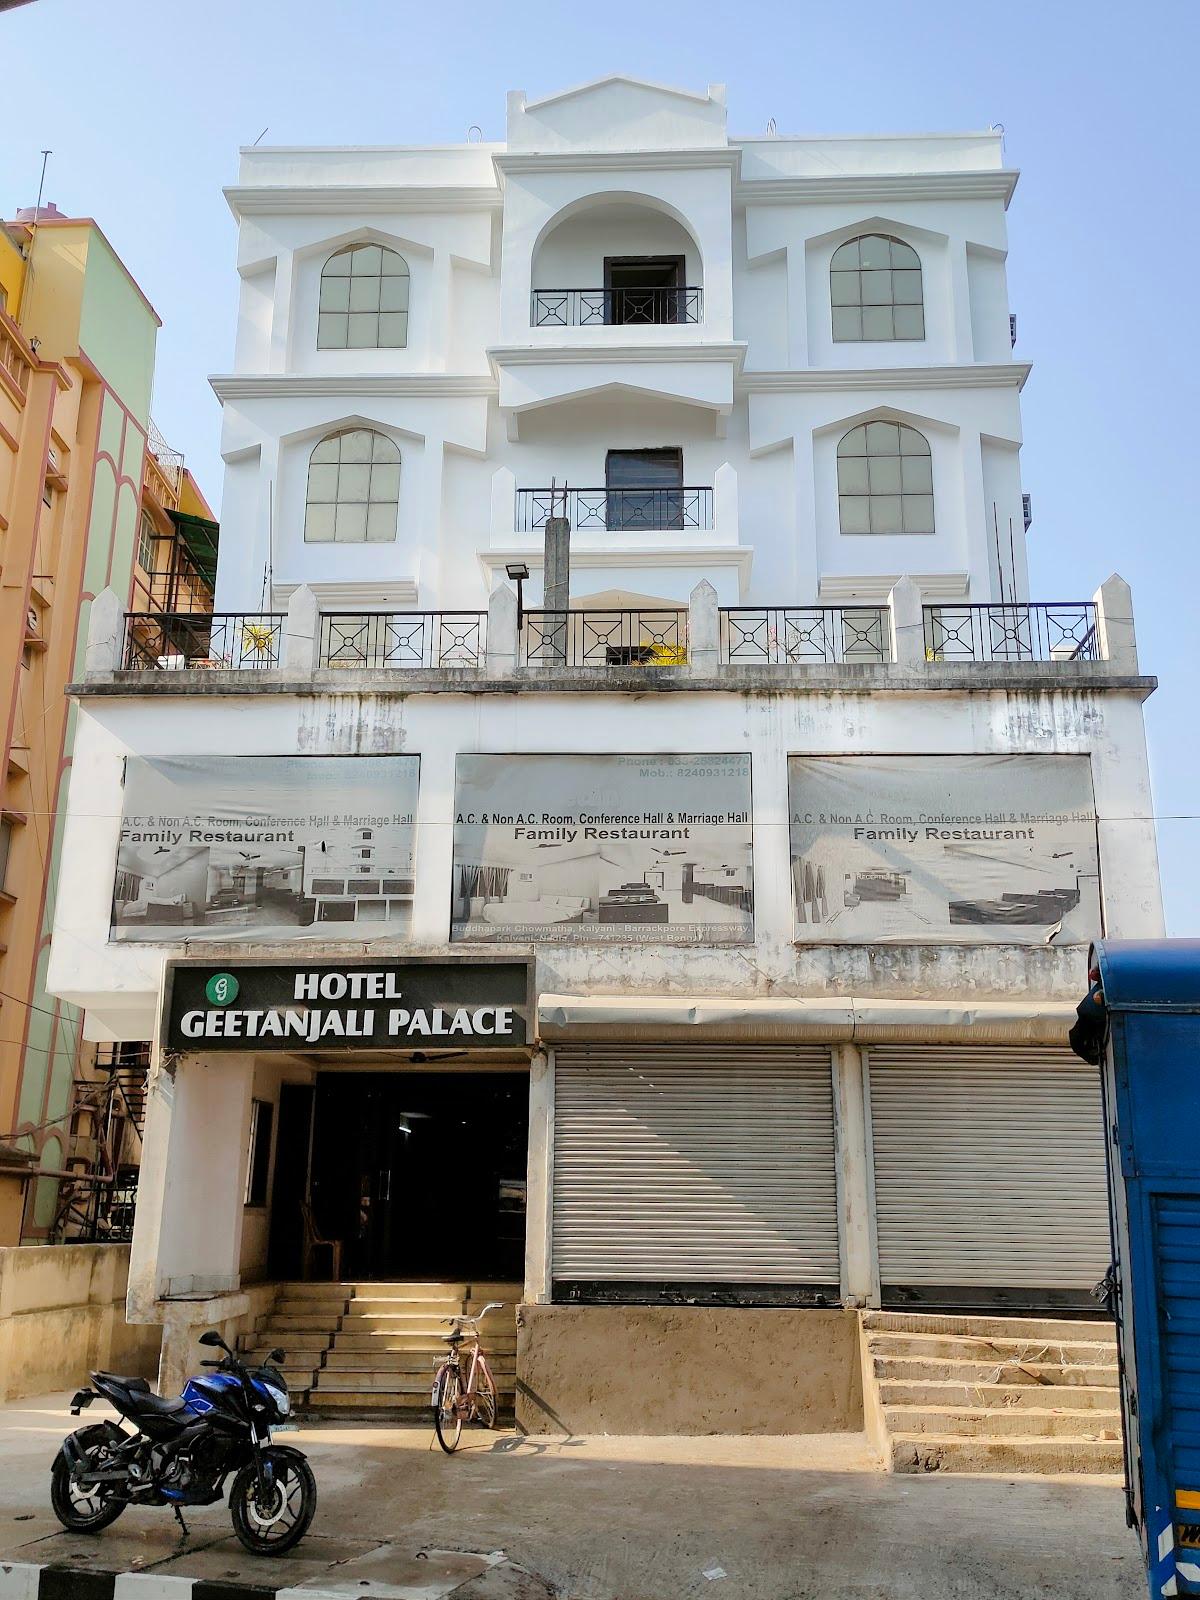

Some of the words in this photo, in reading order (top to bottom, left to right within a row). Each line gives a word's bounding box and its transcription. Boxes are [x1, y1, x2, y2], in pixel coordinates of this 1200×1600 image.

[677, 767, 750, 777] 8240931218
[122, 817, 144, 827] A.C.
[147, 817, 155, 827] &
[158, 816, 180, 826] Non
[207, 816, 243, 828] Room,
[245, 816, 306, 827] Conference
[308, 816, 329, 829] Hall
[332, 817, 341, 826] &
[343, 815, 390, 828] Marriage
[392, 814, 414, 825] Hall
[456, 813, 478, 824] A.C.
[481, 813, 489, 824] &
[492, 813, 514, 824] Non
[516, 813, 539, 824] A.C.
[542, 813, 576, 826] Room,
[579, 812, 641, 824] Conference
[643, 812, 664, 824] Hall
[666, 813, 675, 823] &
[677, 812, 724, 825] Marriage
[727, 811, 748, 823] Hall
[793, 813, 814, 824] A.C.
[818, 814, 826, 824] &
[830, 813, 852, 824] Non
[880, 813, 916, 826] Room,
[918, 813, 982, 825] Conference
[984, 813, 1006, 824] Hall
[1008, 813, 1018, 823] &
[1020, 812, 1069, 826] Marriage
[1071, 812, 1093, 823] Hall
[119, 830, 182, 845] Family
[189, 830, 295, 843] Restaurant
[514, 827, 578, 843] Family
[584, 827, 690, 840] Restaurant
[854, 827, 920, 843] Family
[925, 827, 1035, 840] Restaurant
[578, 924, 615, 935] Kalyani
[624, 924, 686, 935] Barrackpore
[293, 972, 402, 1000] HOTEL
[180, 1008, 375, 1042] GEETANJALI
[387, 1007, 513, 1036] PALACE
